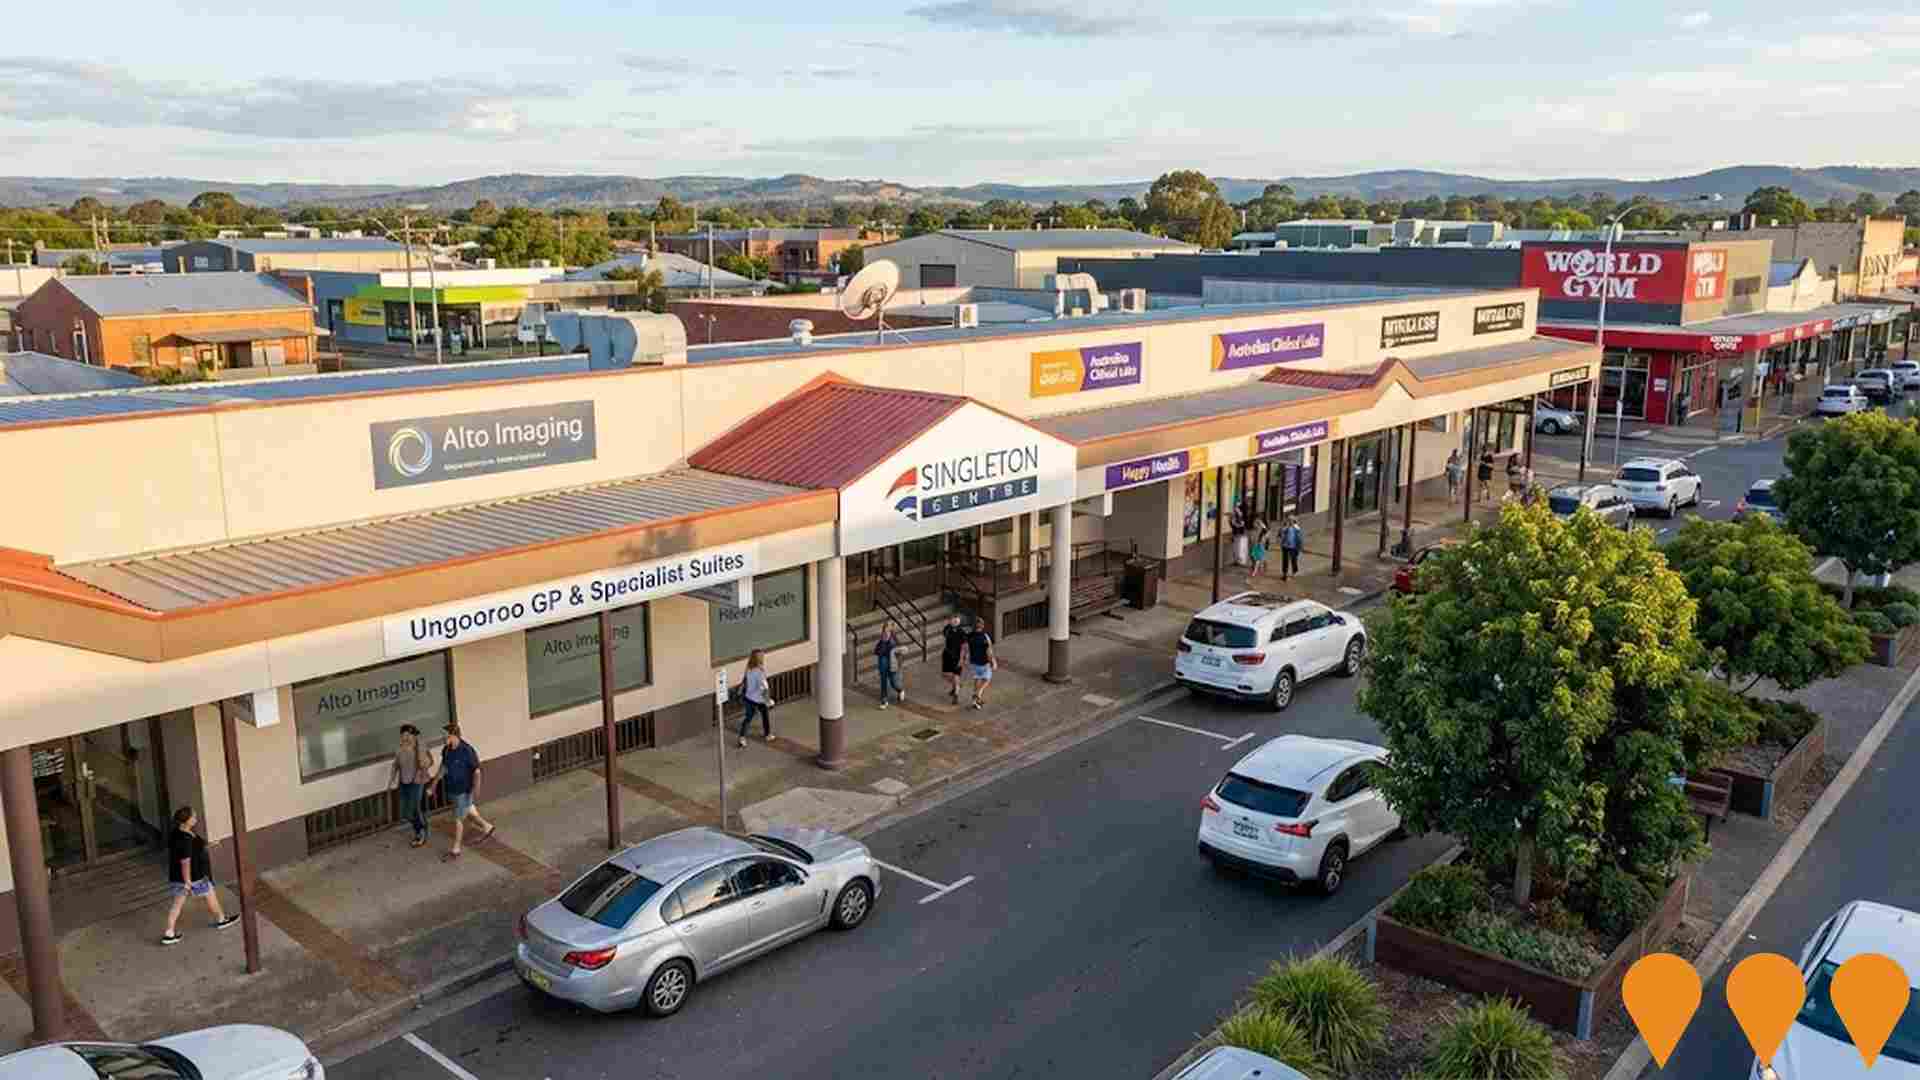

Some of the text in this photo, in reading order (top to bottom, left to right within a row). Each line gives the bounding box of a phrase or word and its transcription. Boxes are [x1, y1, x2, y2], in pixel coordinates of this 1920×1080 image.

[1544, 249, 1663, 276] WORLD
[1562, 276, 1638, 298] GYM
[442, 417, 583, 451] Alto Imaging
[921, 444, 1038, 491] SINGLETON
[410, 552, 744, 641] Ungooroo GP & Specialist Suites
[317, 694, 352, 713] Alto
[357, 677, 426, 703] Imaging
